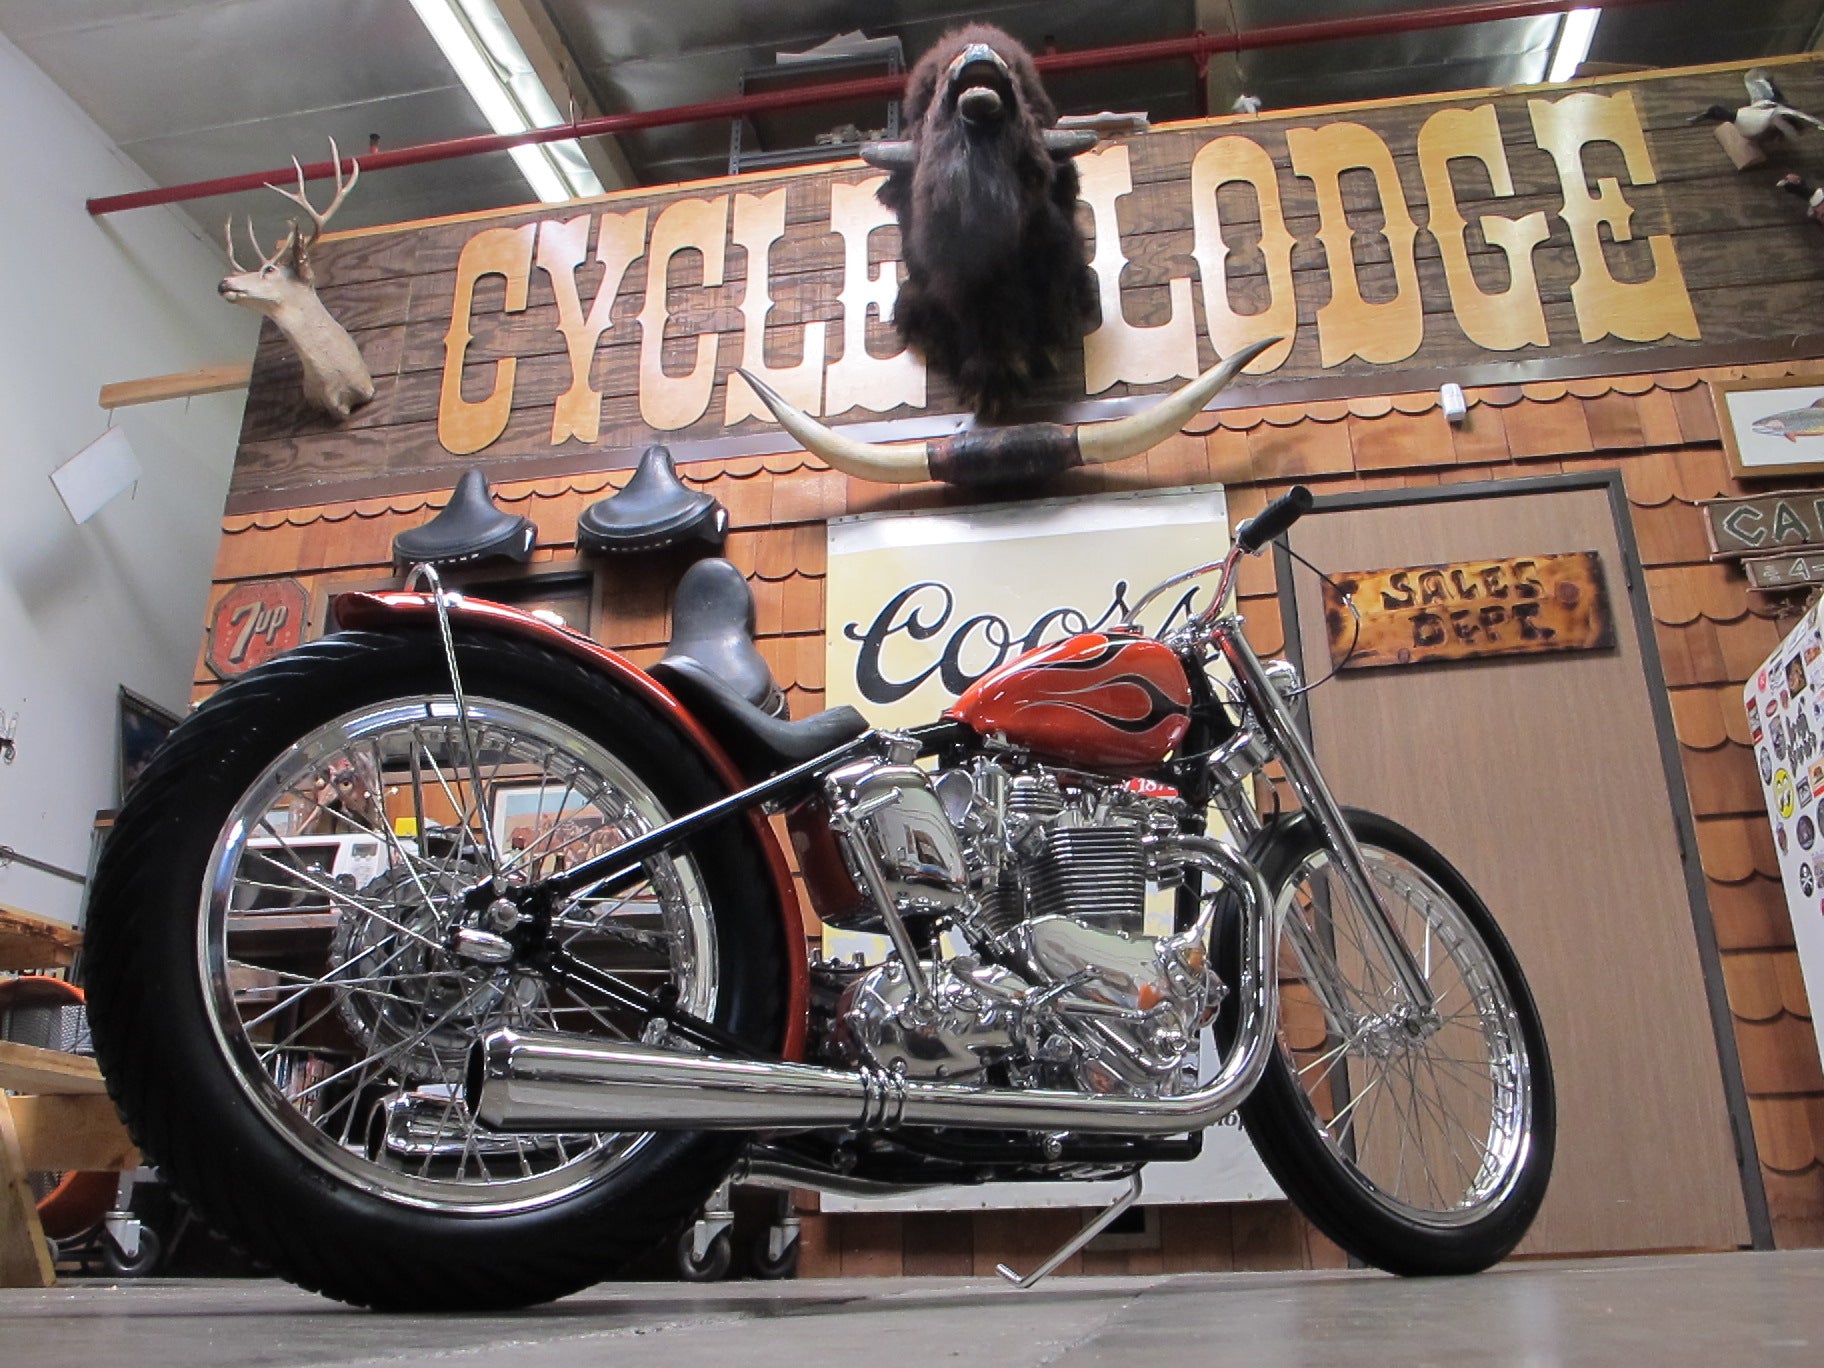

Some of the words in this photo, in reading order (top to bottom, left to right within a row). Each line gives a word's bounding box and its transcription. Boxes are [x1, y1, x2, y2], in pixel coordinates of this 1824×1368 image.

[437, 177, 927, 456] CYCLE
[1077, 90, 1701, 395] LODGE
[1724, 502, 1824, 547] CA
[1380, 561, 1546, 611] SALES
[843, 580, 1219, 704] Coo
